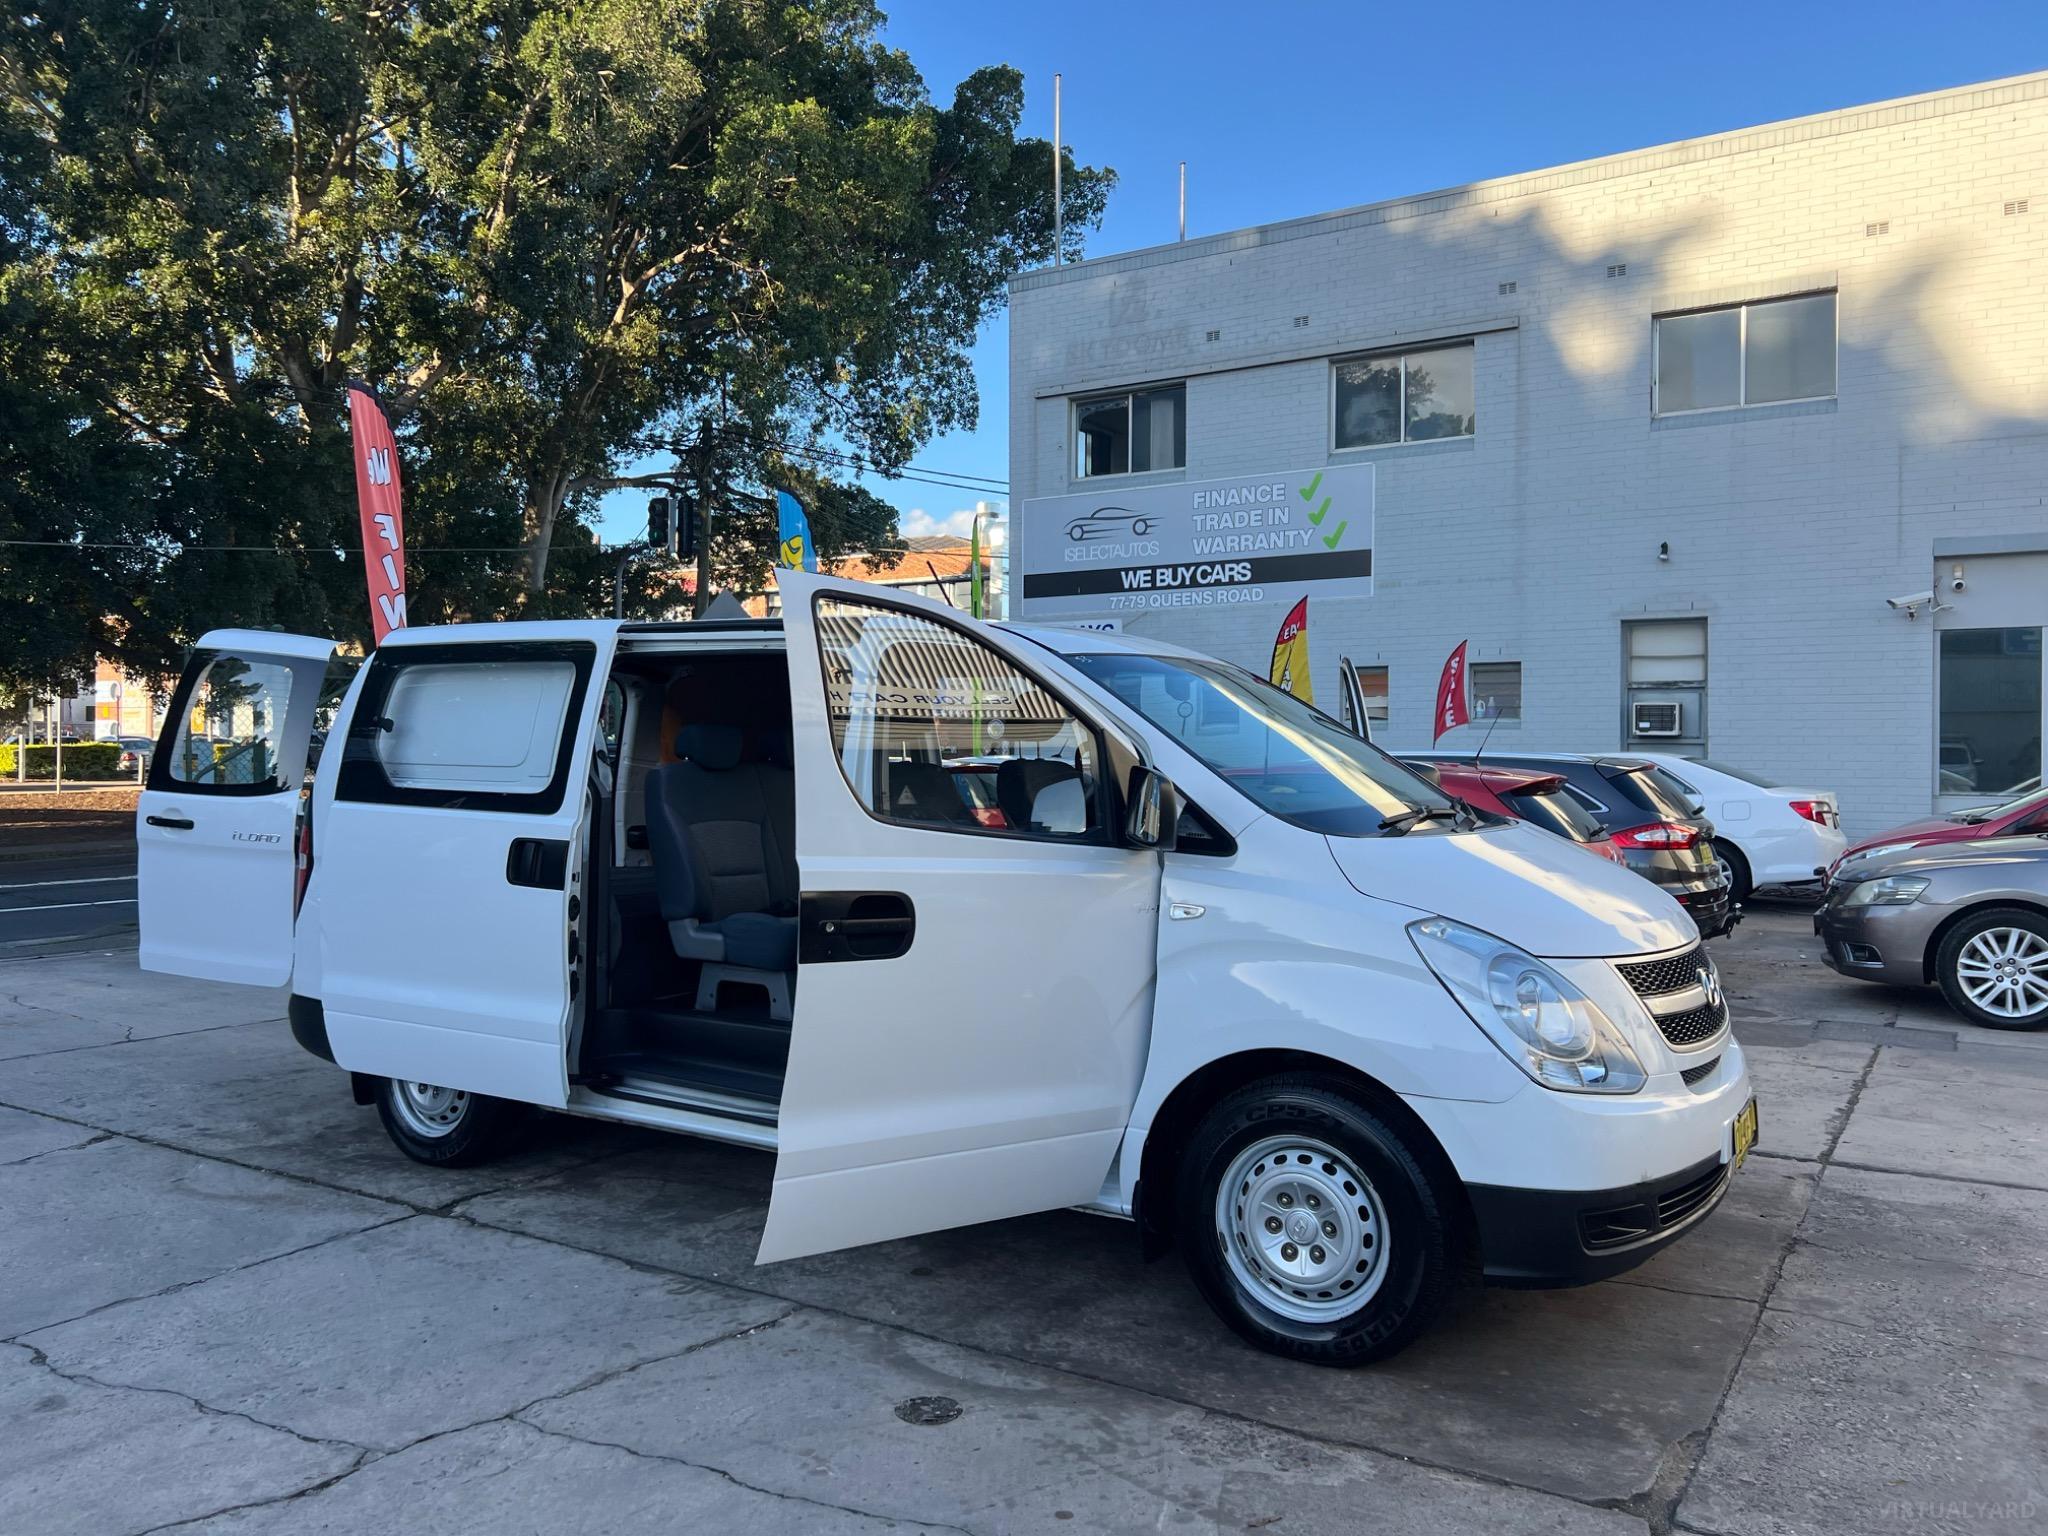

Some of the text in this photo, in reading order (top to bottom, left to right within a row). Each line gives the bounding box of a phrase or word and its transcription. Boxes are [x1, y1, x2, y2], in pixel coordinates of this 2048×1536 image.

[1192, 483, 1286, 509] FINANCE
[1192, 507, 1289, 532] TRADE IN
[1192, 528, 1314, 556] WARRANTY
[1121, 562, 1252, 589] WE BUY CARS
[1109, 587, 1264, 610] 77-79 QUEENS ROAD
